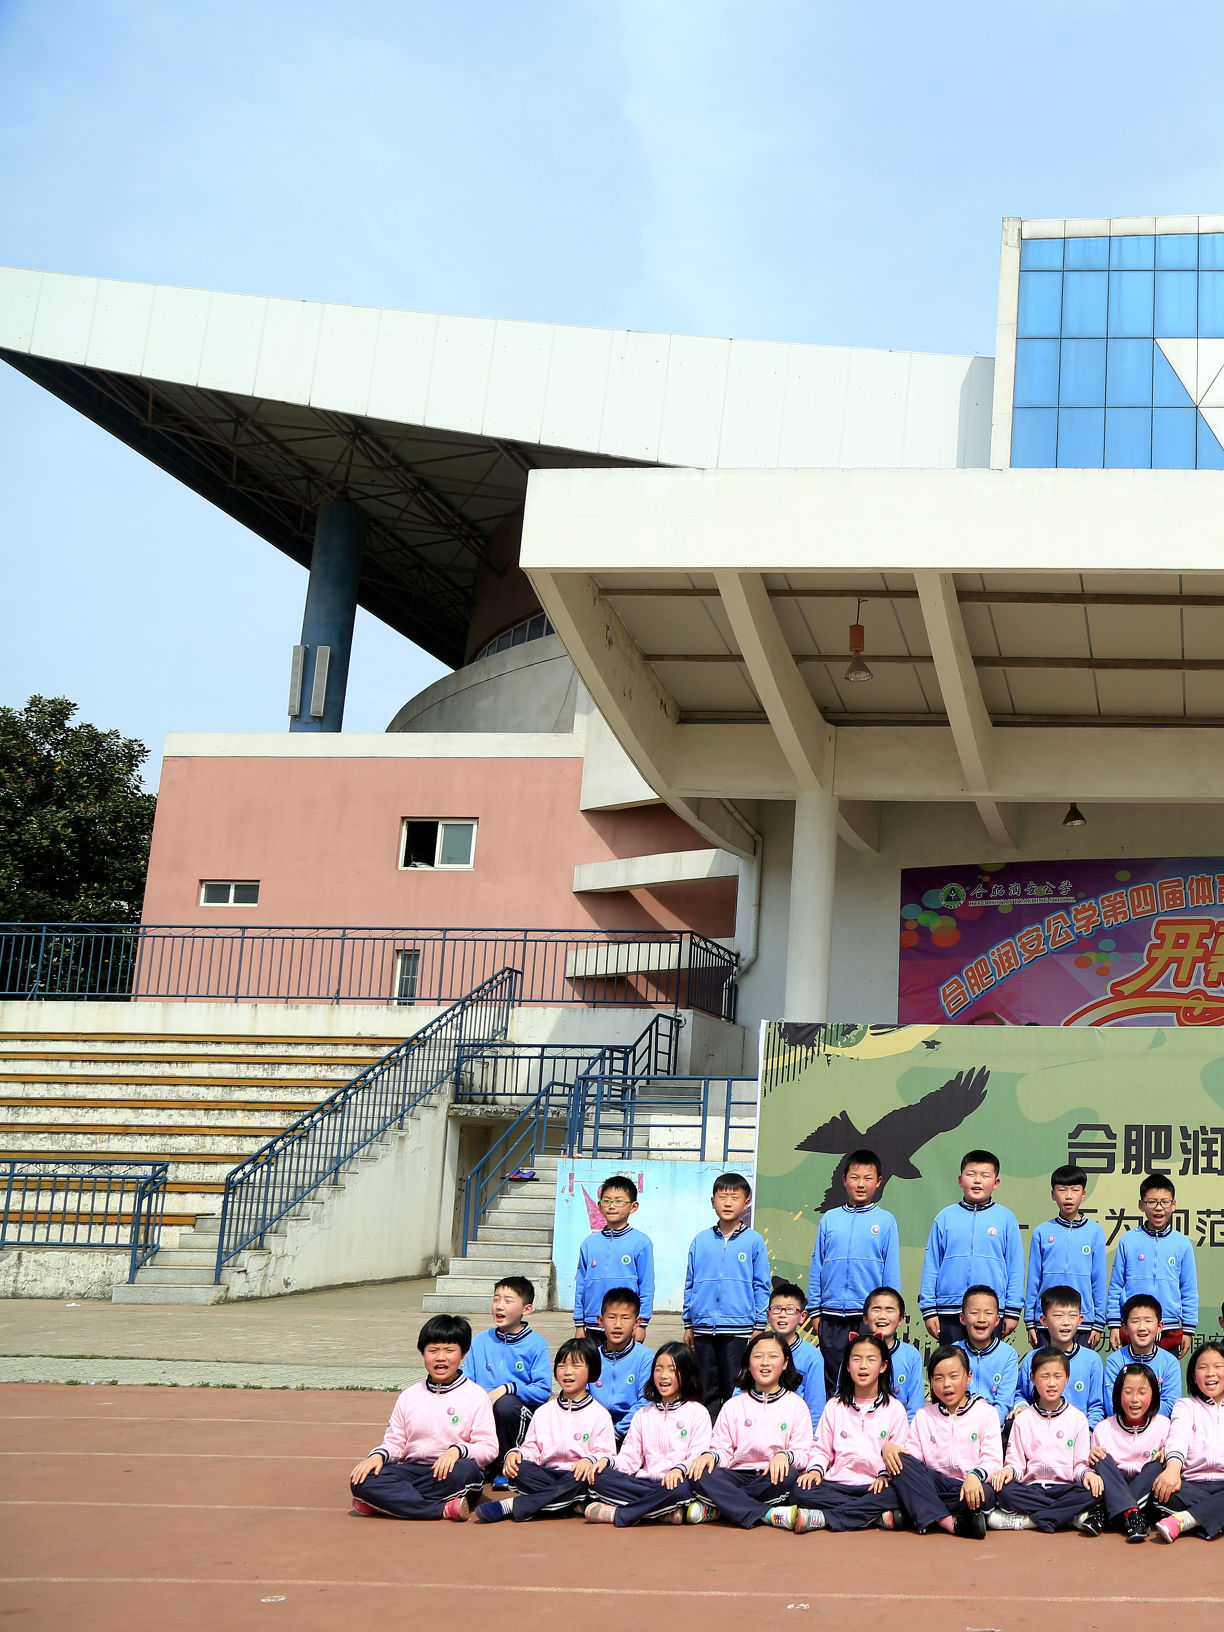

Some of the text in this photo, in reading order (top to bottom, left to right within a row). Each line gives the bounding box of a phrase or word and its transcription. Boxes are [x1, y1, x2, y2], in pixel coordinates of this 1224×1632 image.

[970, 880, 1073, 898] 合肥润安公学
